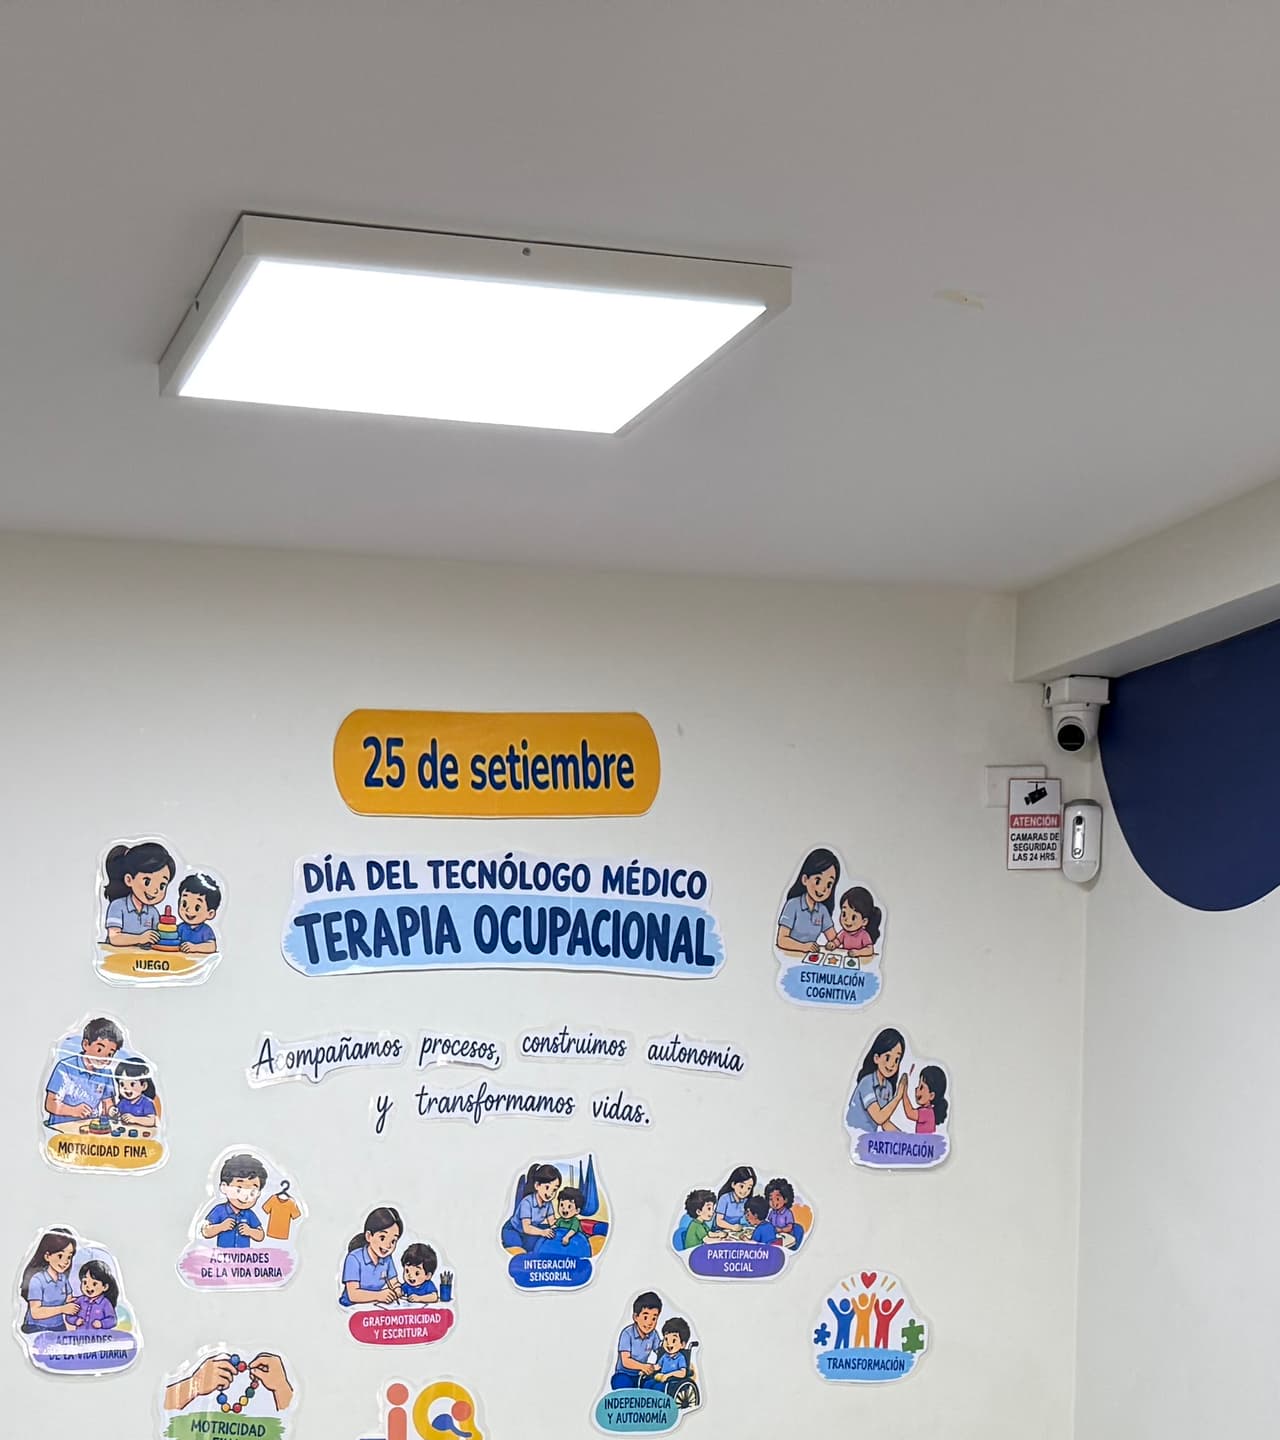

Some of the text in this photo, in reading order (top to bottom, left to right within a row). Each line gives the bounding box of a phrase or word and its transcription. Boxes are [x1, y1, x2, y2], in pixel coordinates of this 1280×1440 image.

[362, 736, 635, 791] 25 de setiembre
[1050, 832, 1060, 842] DE
[1013, 842, 1057, 852] SEGURIDAD
[1012, 852, 1028, 862] LAS
[1029, 852, 1039, 861] 24
[303, 853, 707, 899] DÍA DEL TECNÓLOGO MÉDICO
[294, 905, 716, 967] TERAPIA OCUPACIONAL
[132, 960, 170, 971] JUEGO
[800, 971, 865, 987] ESTIMULACIÓN
[806, 986, 857, 1001] COGNITIVA
[419, 1032, 501, 1070] procesos,
[522, 1025, 627, 1057] construimos
[376, 1083, 652, 1134] y transformamos vidas.
[58, 1142, 148, 1158] MOTRICIDAD FINA
[868, 1140, 935, 1158] PARTICIPACIÓN
[209, 1252, 270, 1264] ACTIVIDADES
[707, 1248, 769, 1260] PARTICIPACIÓN
[524, 1257, 576, 1270] INTEGRACIÓN
[723, 1262, 753, 1272] SOCIAL
[201, 1267, 282, 1278] DE LA VIDA DIARIA
[529, 1271, 572, 1281] SENSORIAL
[363, 1313, 441, 1327] GRAFOMOTRICIDAD
[56, 1334, 113, 1346] ACTIVIDADES
[374, 1327, 428, 1340] Y ESCRITURA
[77, 1350, 97, 1360] VIDA
[100, 1349, 128, 1359] DIARIA
[827, 1356, 905, 1371] TRANSFORMACIÓN
[604, 1397, 671, 1410] INDEPENDENCIA
[607, 1410, 667, 1424] Y AUTONOMÍA
[191, 1419, 266, 1437] MOTRICIDAD
